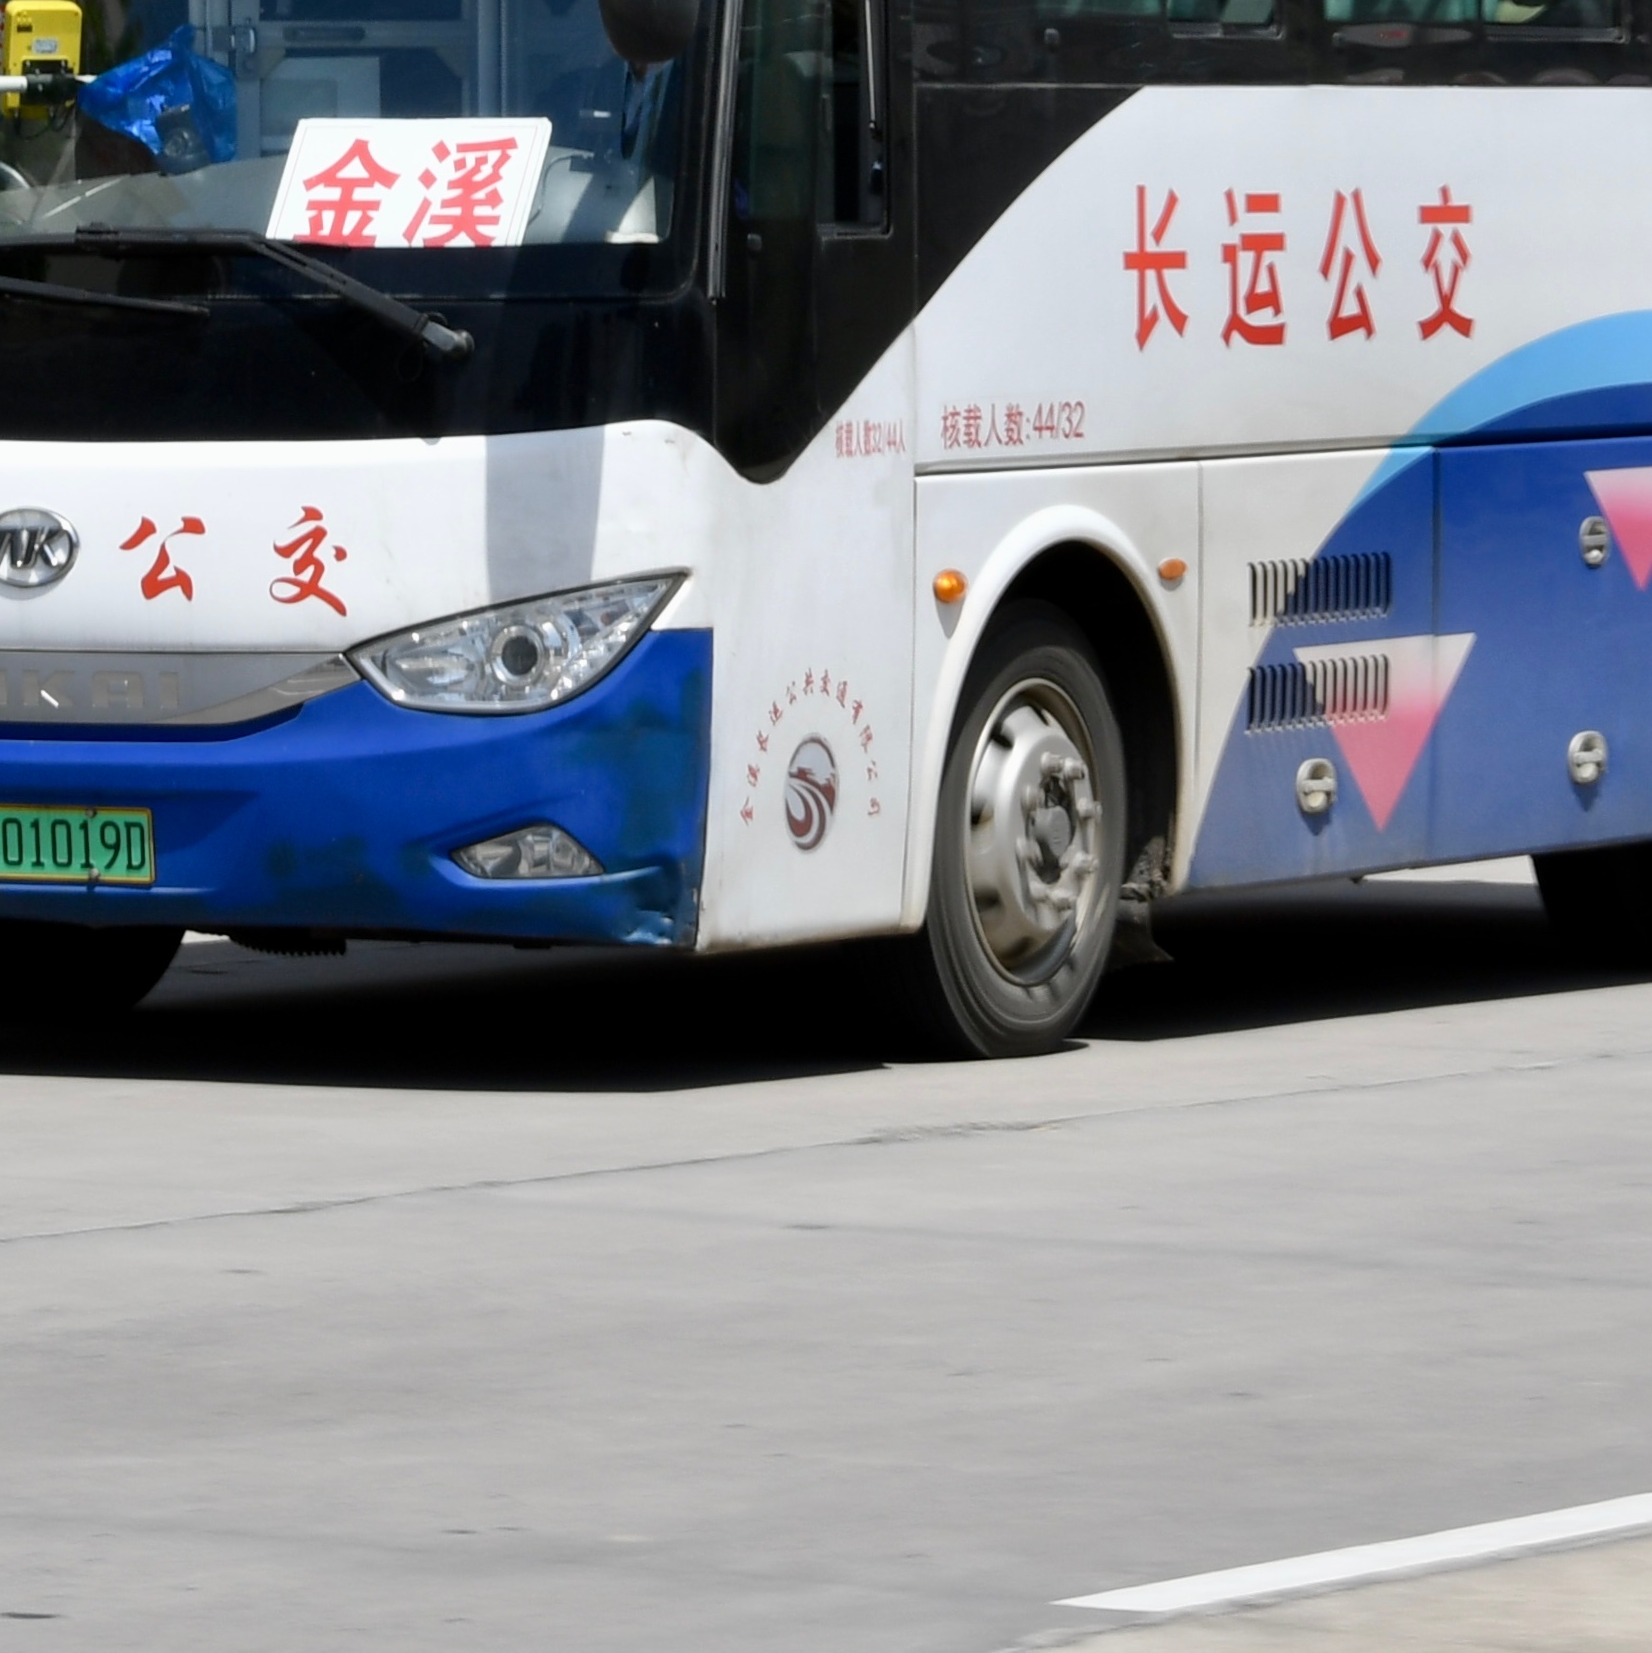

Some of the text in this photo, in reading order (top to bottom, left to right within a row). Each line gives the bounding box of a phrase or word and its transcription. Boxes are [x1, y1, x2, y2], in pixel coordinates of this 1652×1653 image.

[291, 135, 518, 248] 金溪
[1122, 185, 1475, 351] 长运公交
[940, 401, 1086, 450] 核载人数:44/32
[119, 505, 349, 617] 公交
